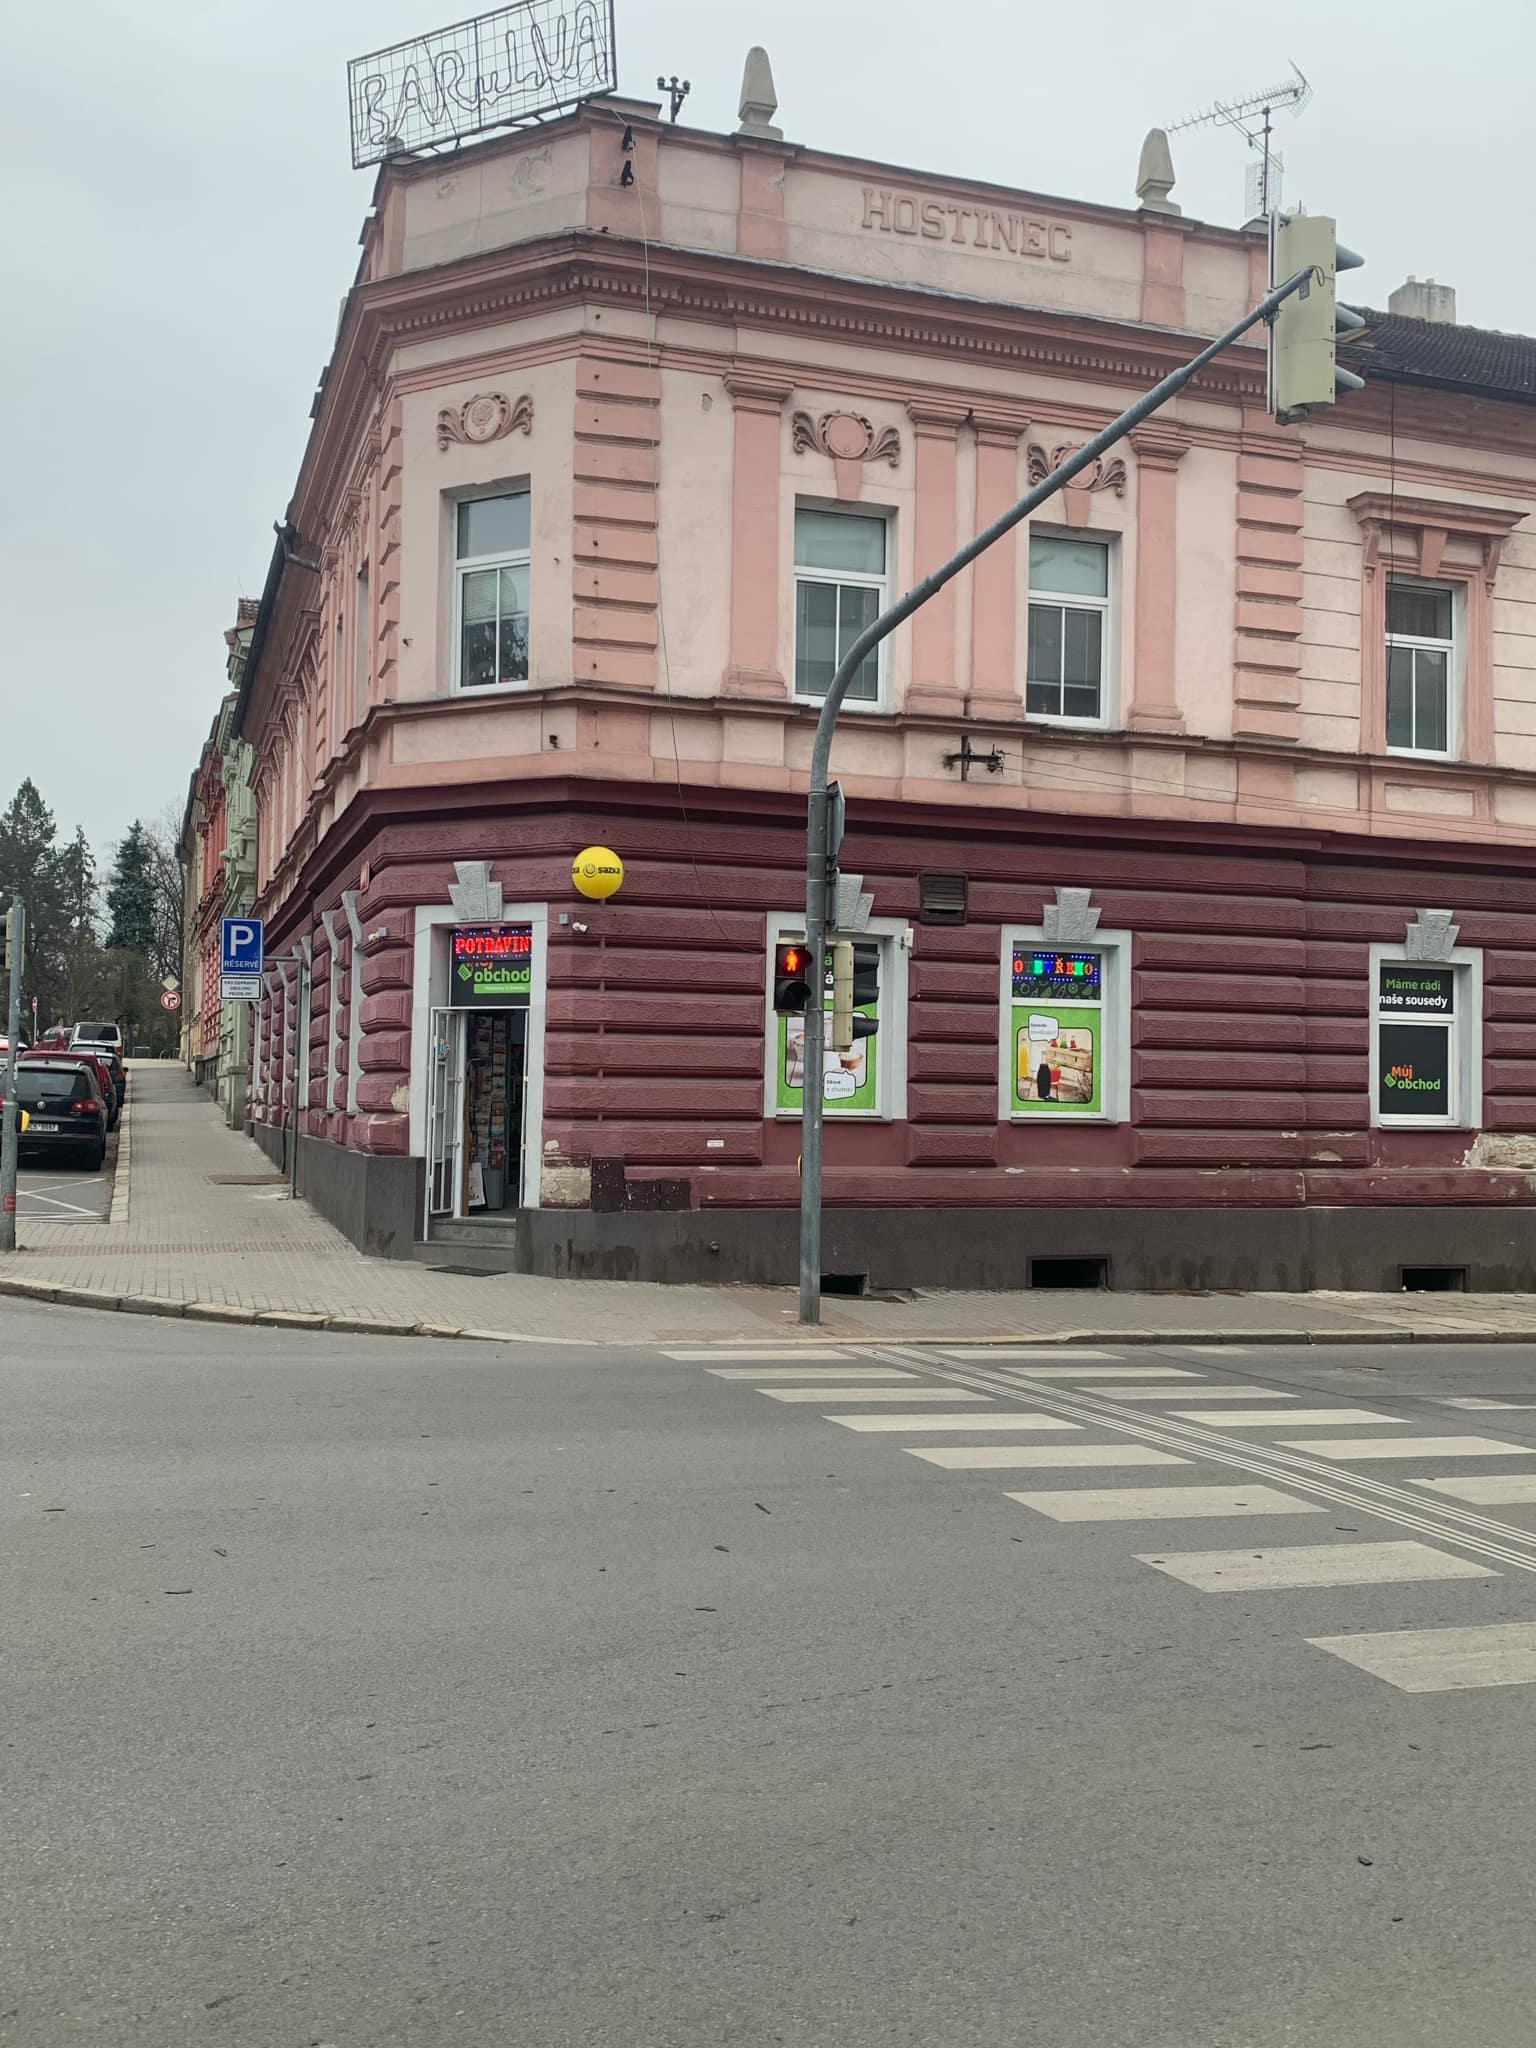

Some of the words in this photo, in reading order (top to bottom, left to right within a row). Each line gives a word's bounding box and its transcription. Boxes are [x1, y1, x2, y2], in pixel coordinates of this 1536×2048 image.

[360, 50, 477, 146] BAR
[861, 187, 1072, 262] HOSTINEC
[230, 925, 254, 957] P
[474, 967, 530, 982] obchod
[1386, 977, 1418, 990] Máme
[1420, 979, 1441, 991] rádi
[1379, 993, 1403, 1005] naše
[1405, 995, 1448, 1008] sousedy
[1397, 1078, 1441, 1090] obchod
